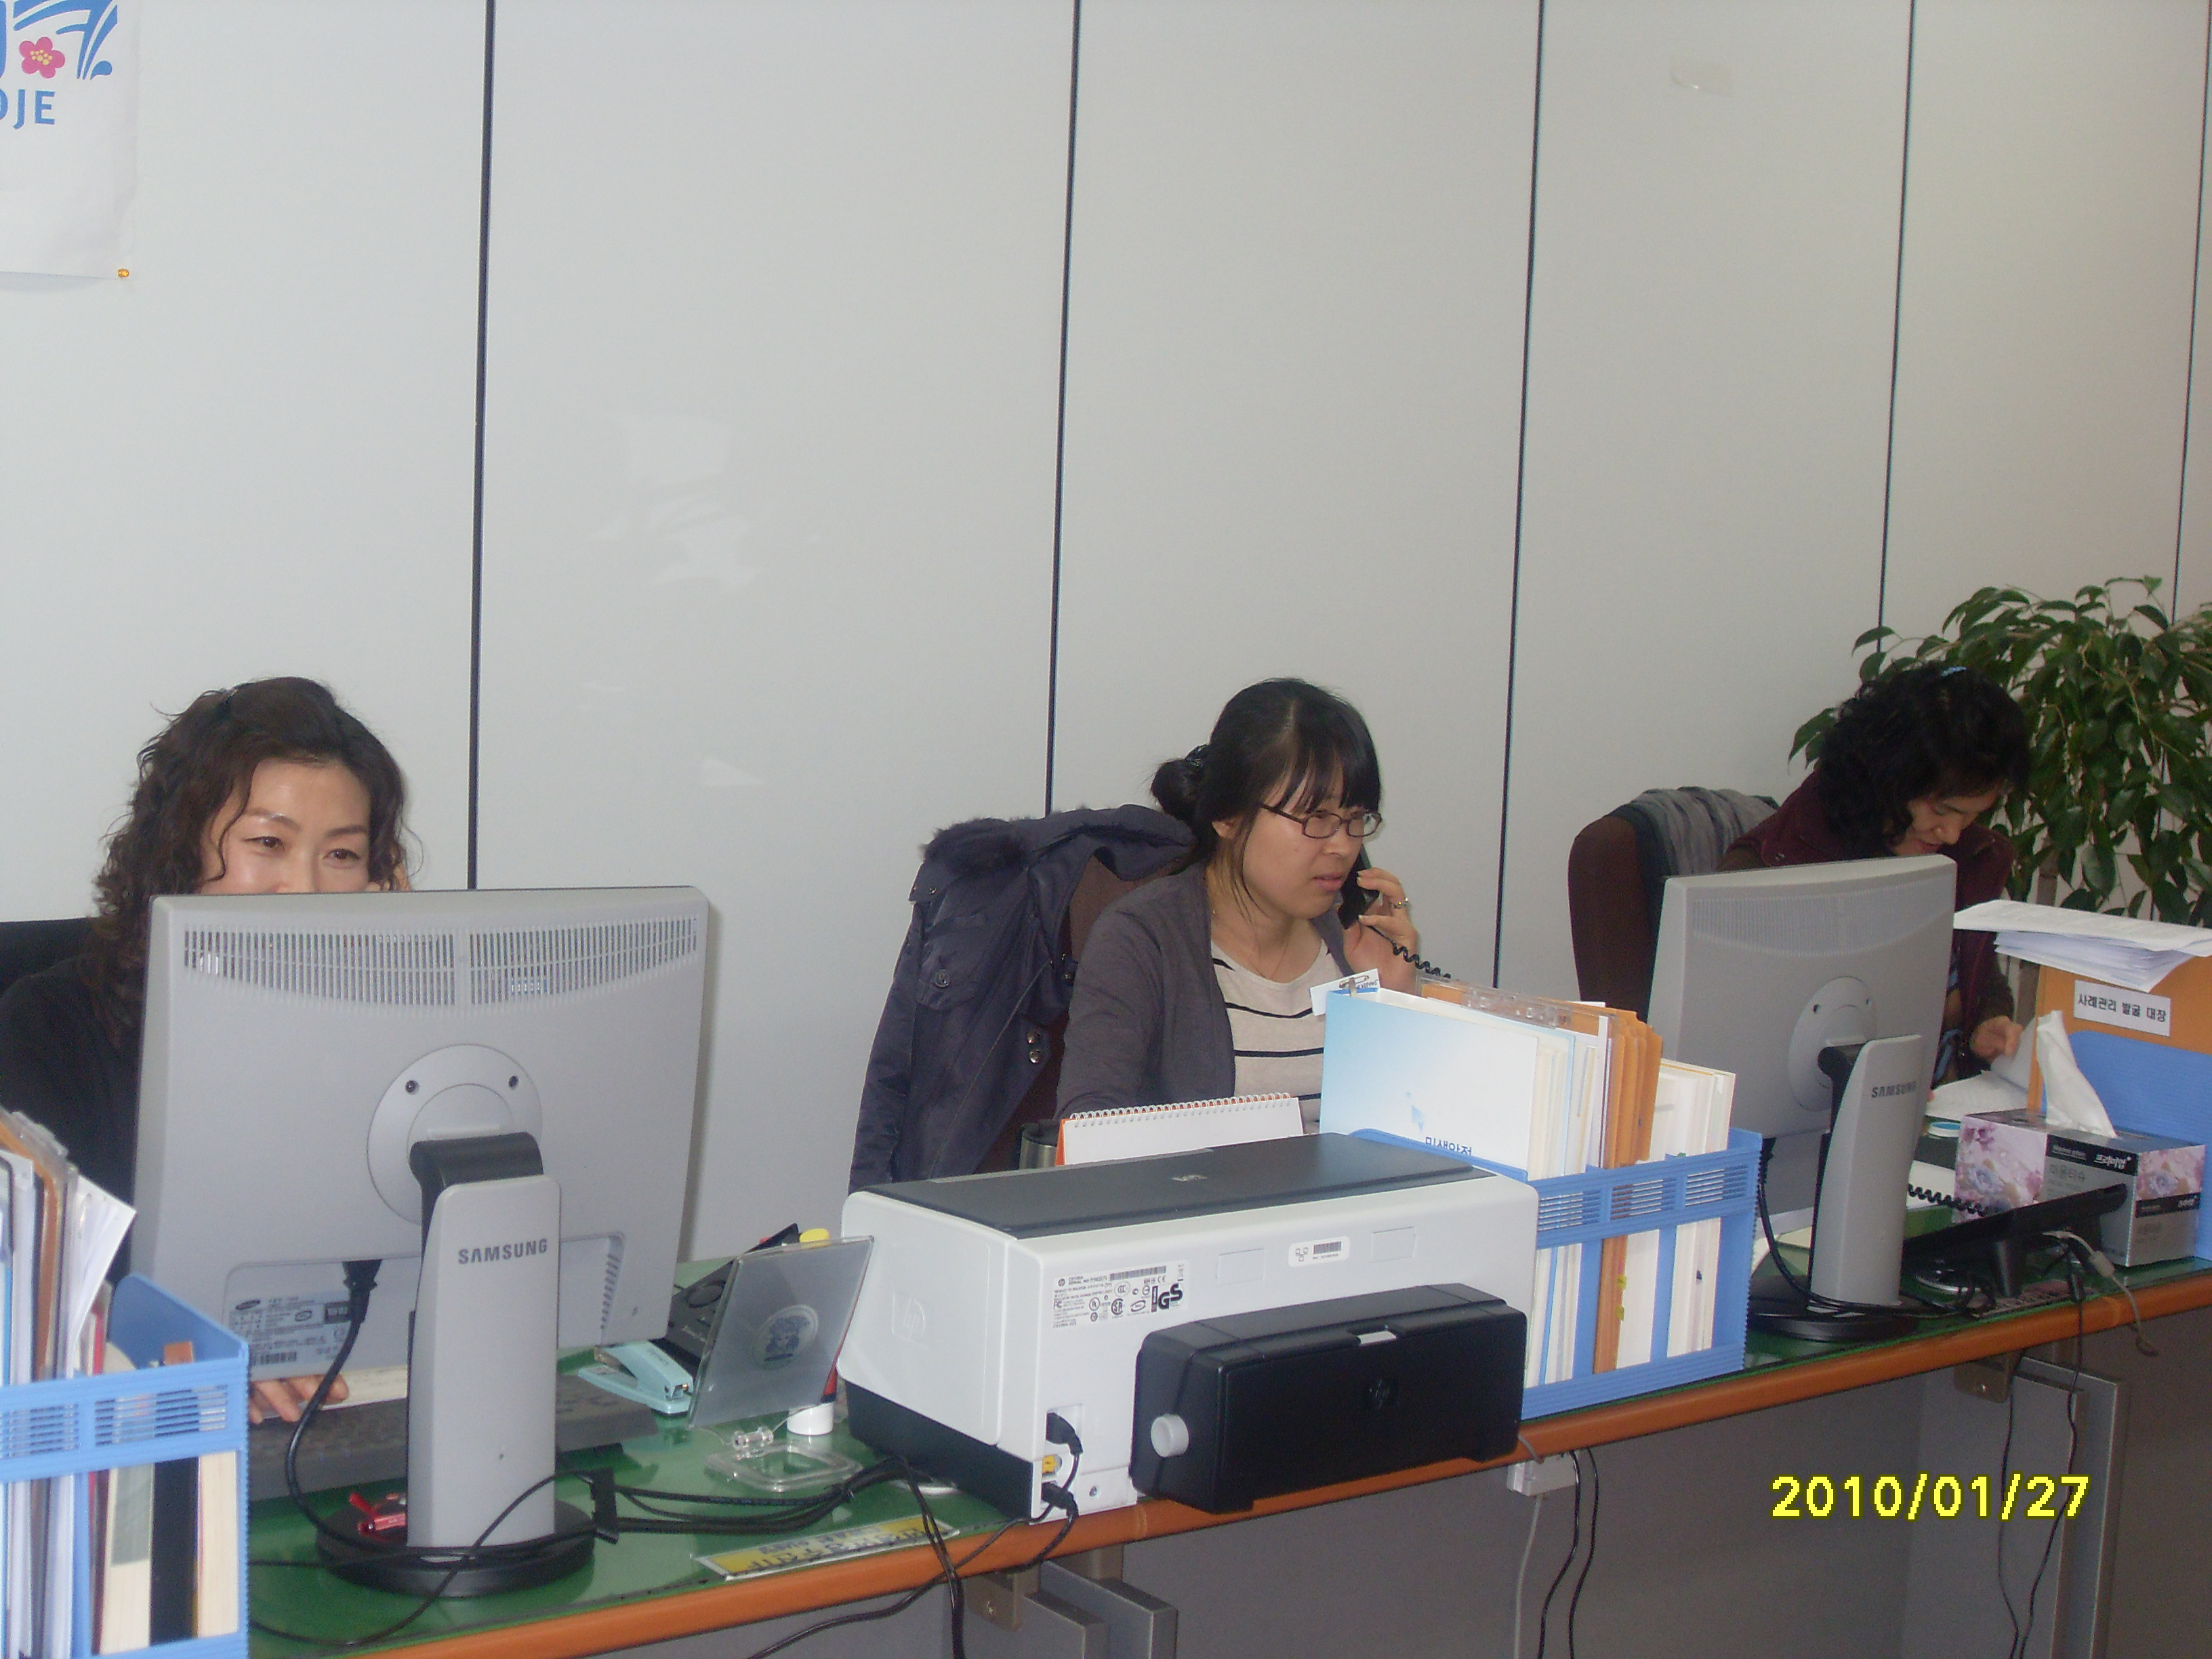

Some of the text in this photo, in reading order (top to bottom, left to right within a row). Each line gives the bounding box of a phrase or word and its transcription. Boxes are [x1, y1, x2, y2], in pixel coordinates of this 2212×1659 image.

[0, 89, 56, 129] JE
[2078, 994, 2167, 1023] 사례관리 발굴 대장
[458, 1237, 547, 1265] SAMSUNG
